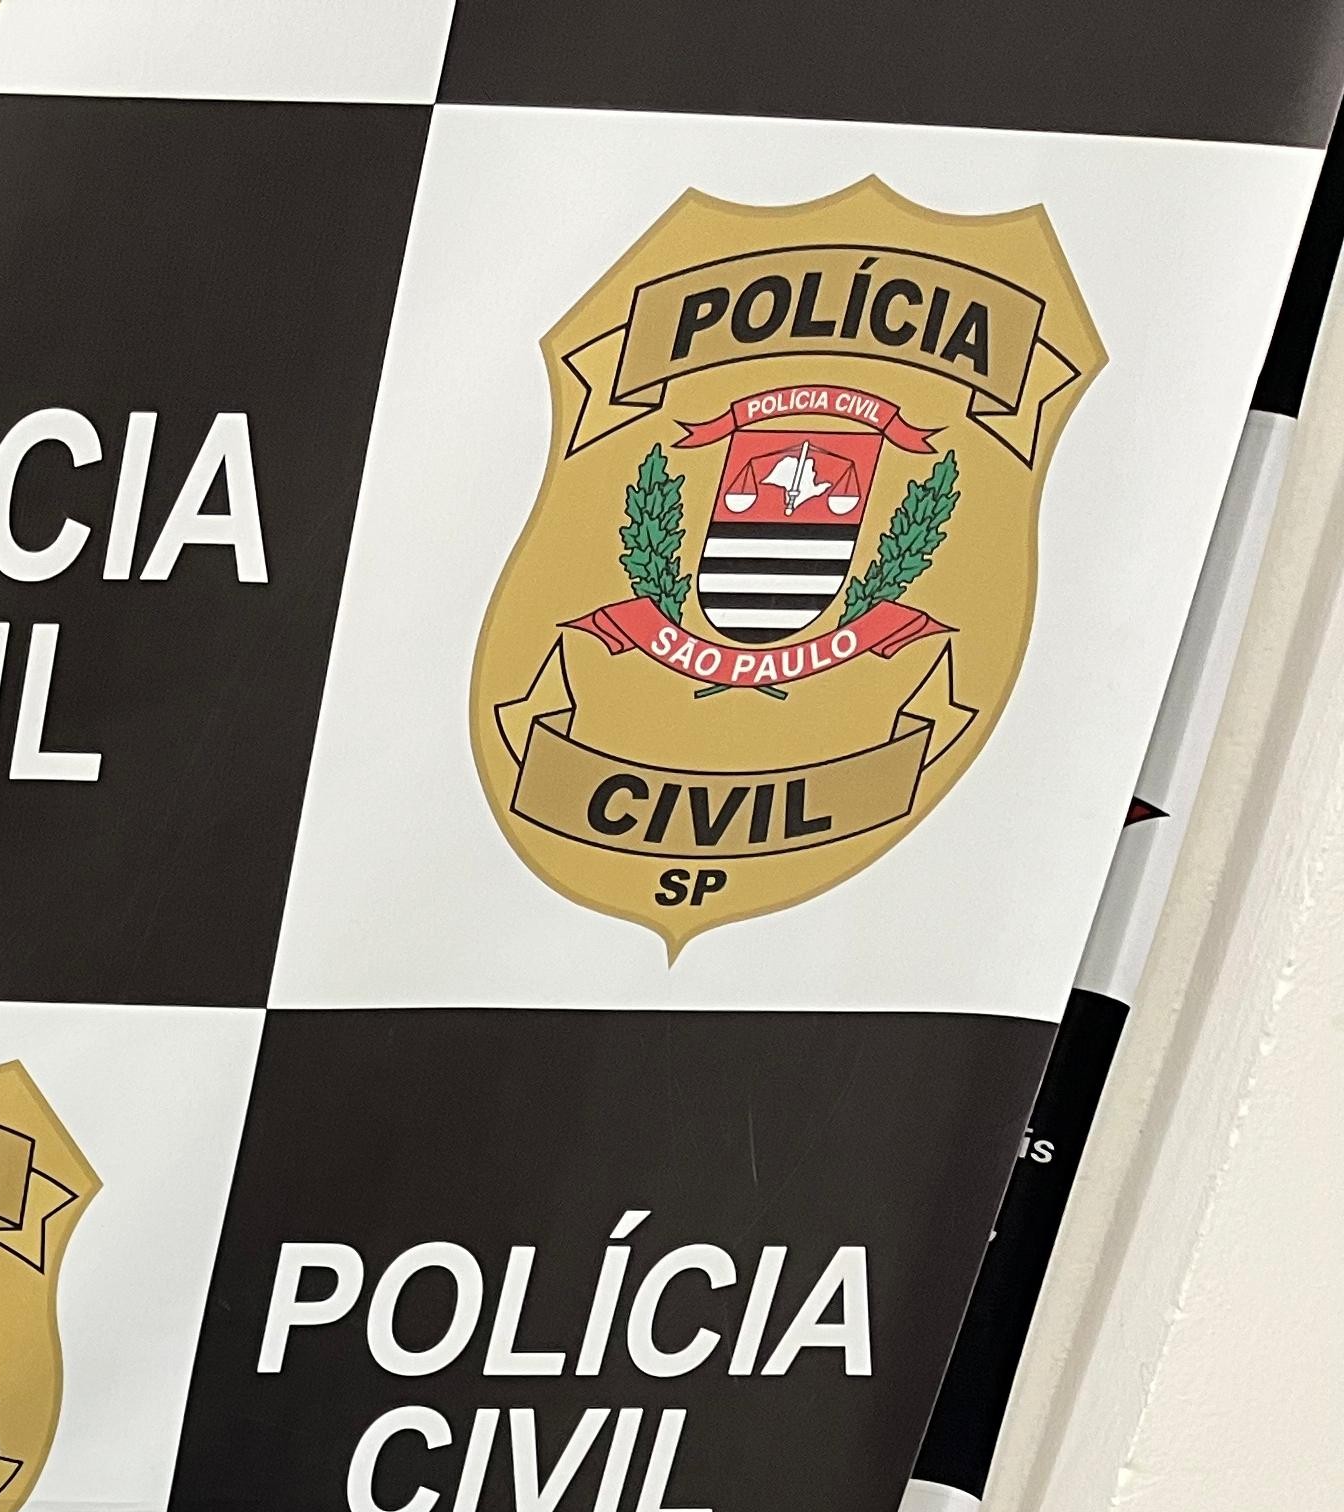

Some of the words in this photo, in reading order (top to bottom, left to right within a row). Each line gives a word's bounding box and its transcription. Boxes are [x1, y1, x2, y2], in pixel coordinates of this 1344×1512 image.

[670, 258, 989, 376] POLÍCIA
[747, 389, 829, 418] POLÍCIA
[835, 393, 880, 422] CIVIL
[651, 626, 722, 677] SÃO
[731, 629, 857, 683] PAULO
[588, 774, 831, 845] CIVIL
[655, 869, 726, 906] SP
[257, 1211, 871, 1377] POLÍCIA
